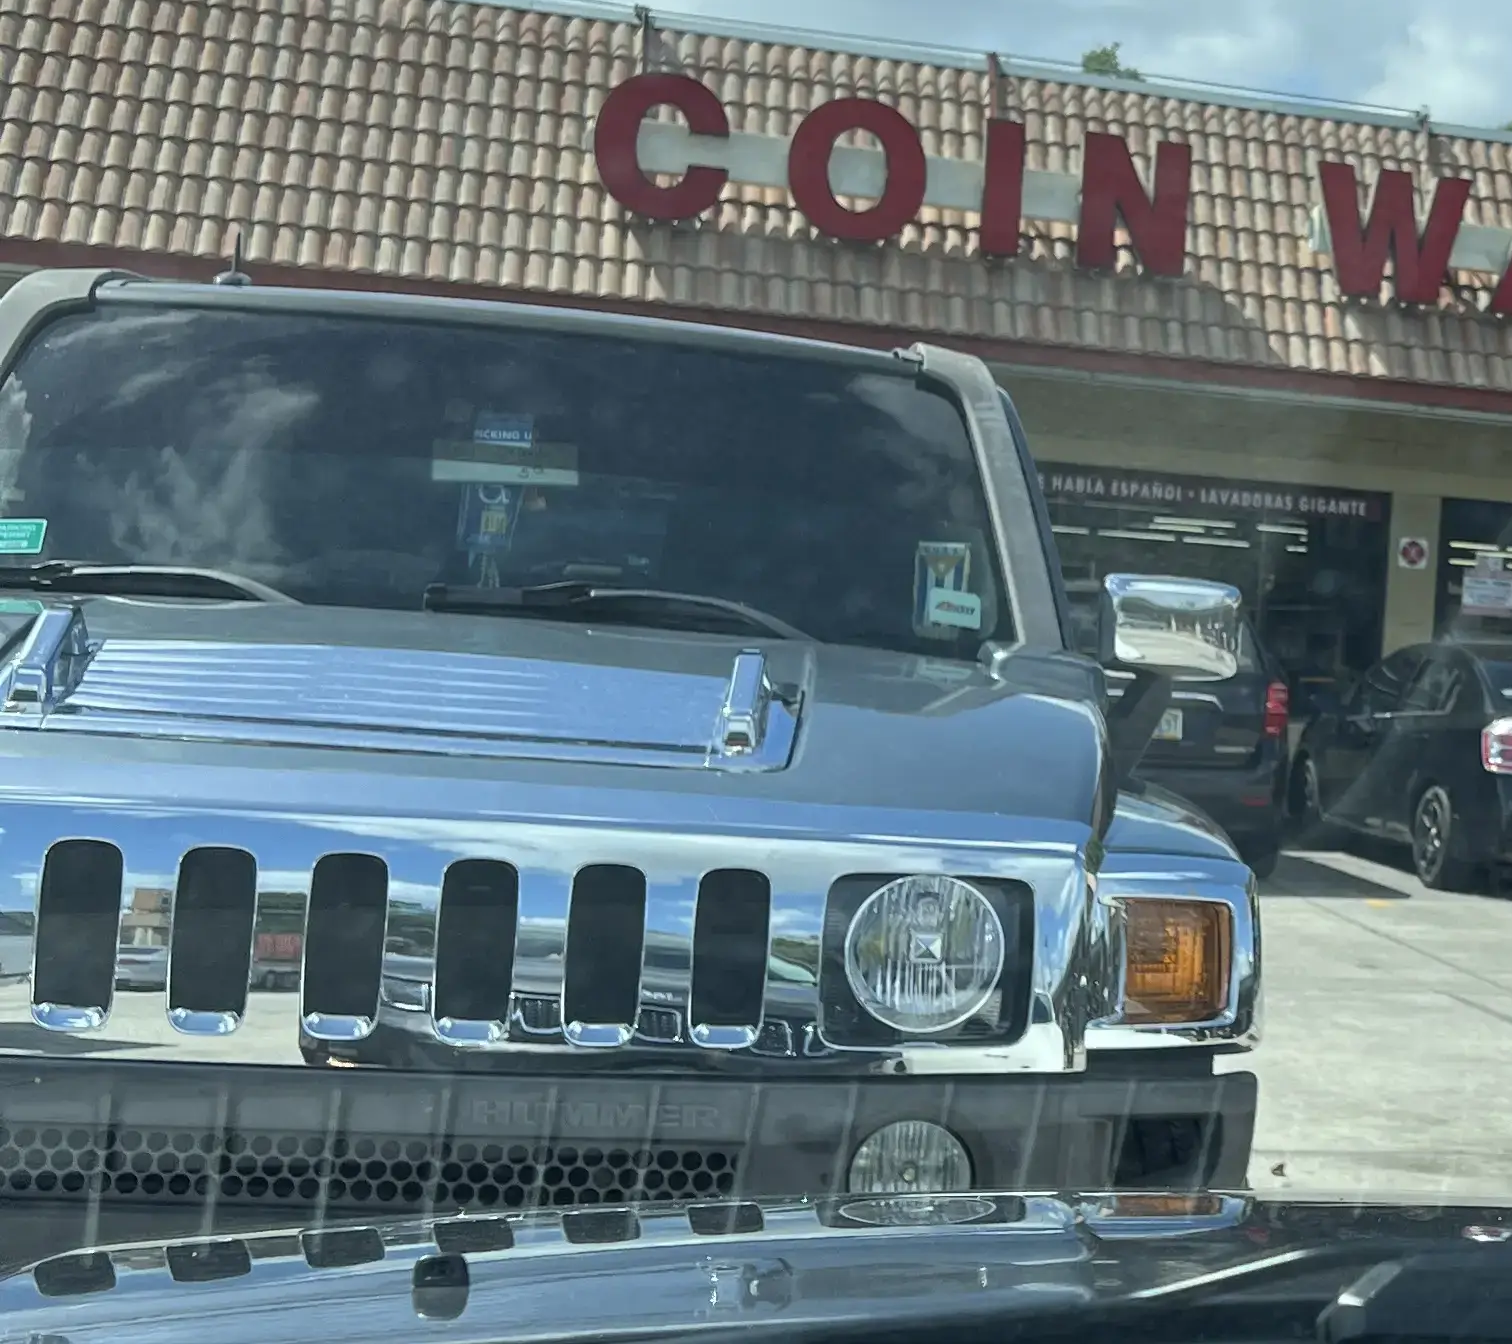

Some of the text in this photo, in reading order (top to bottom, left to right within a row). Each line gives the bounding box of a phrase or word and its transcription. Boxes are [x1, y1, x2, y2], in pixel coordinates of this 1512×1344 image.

[594, 73, 1192, 276] COIN
[1052, 474, 1105, 496] HABLA
[1111, 478, 1182, 502] ESPAÑOL
[1200, 487, 1293, 511] LAVADORAS
[1299, 497, 1367, 517] GIGANTE
[472, 1098, 719, 1129] HUMMER
